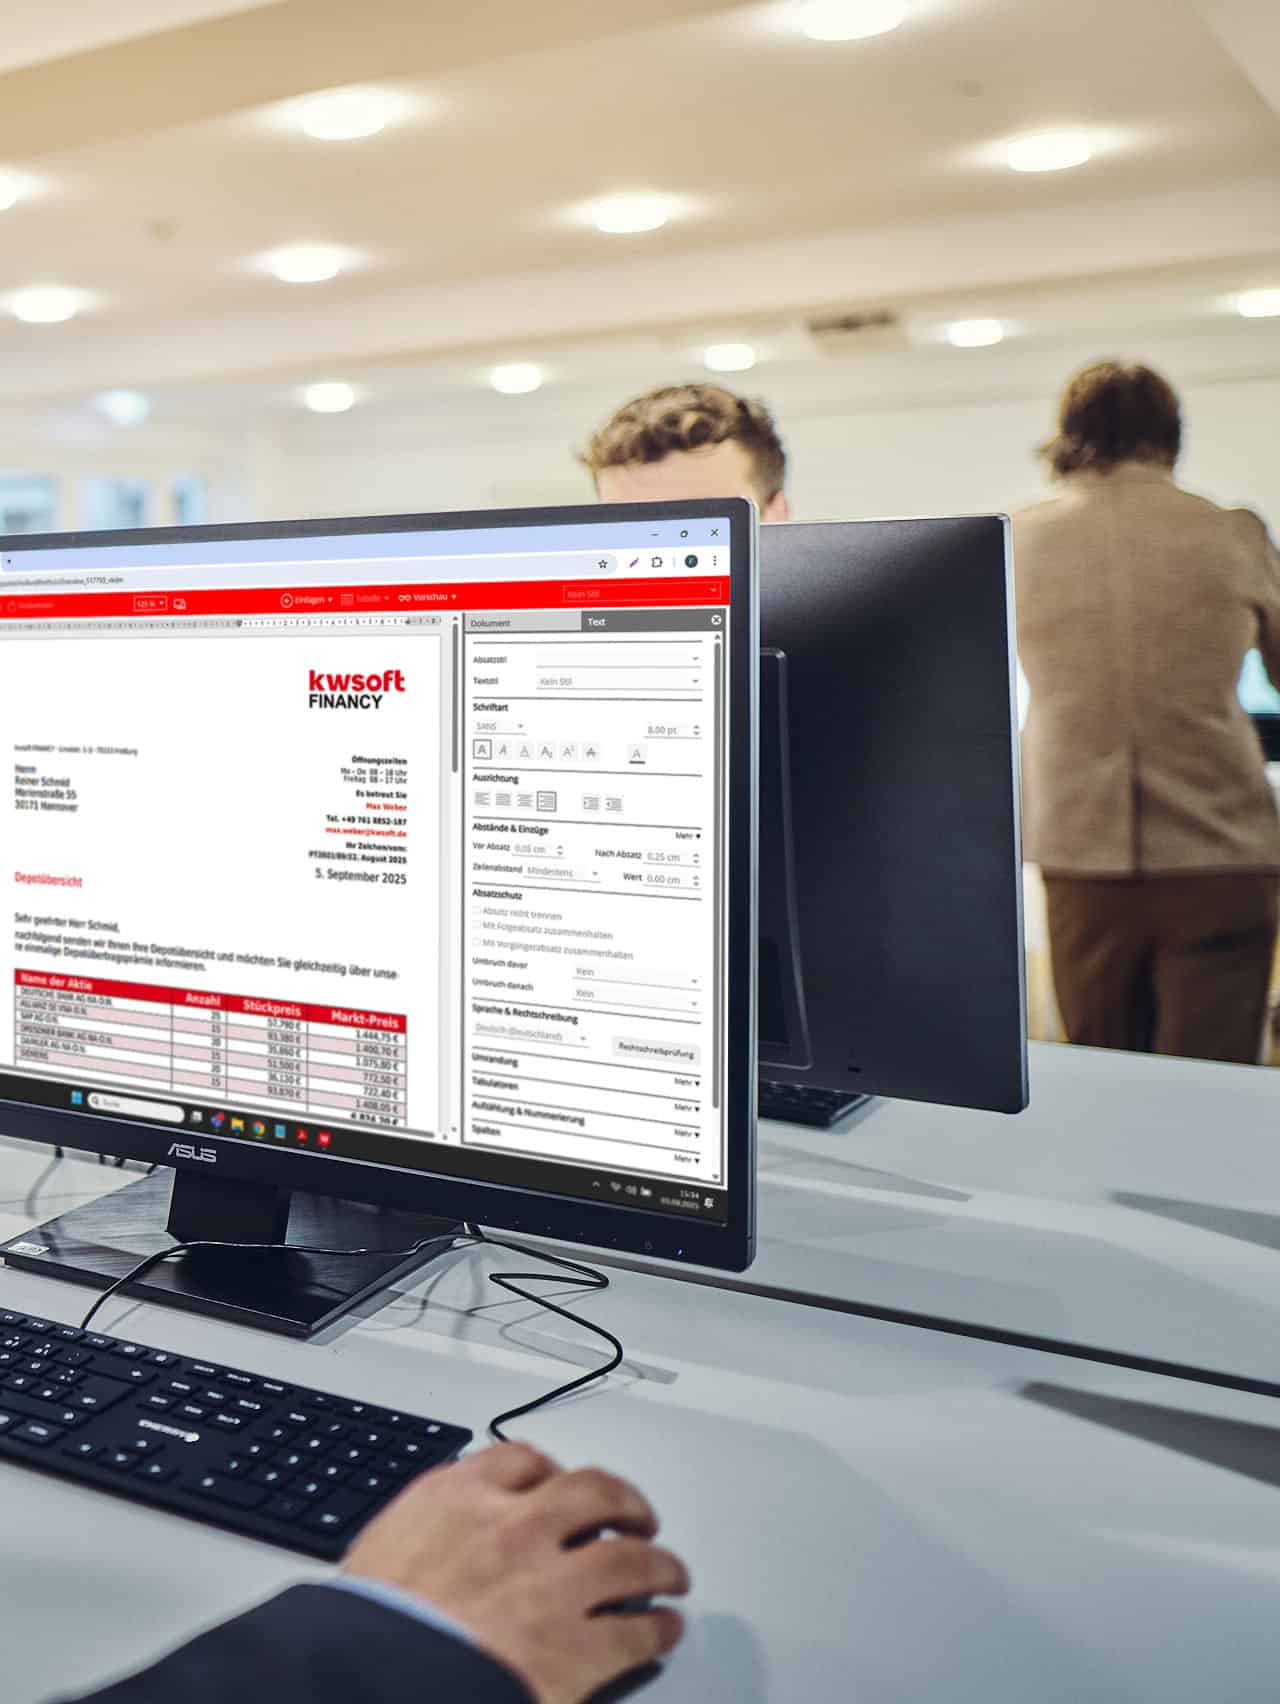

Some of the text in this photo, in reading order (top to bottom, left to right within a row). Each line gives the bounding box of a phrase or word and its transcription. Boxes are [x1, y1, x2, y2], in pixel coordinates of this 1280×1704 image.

[414, 593, 448, 601] Vorschau
[470, 619, 510, 627] Dokument
[588, 618, 605, 626] Text
[473, 655, 507, 664] Absatzstil
[309, 669, 405, 692] kwsoft
[309, 694, 383, 709] FINANCY
[473, 703, 509, 712] Schriftart
[668, 727, 677, 735] pt
[352, 755, 407, 766] Öffnungszeiten
[15, 776, 70, 787] Reiner Schmid
[473, 774, 518, 784] Ausrichtung
[15, 788, 64, 799] Marienstraße
[366, 790, 393, 798] betreut
[41, 801, 78, 812] Hannover
[366, 802, 407, 811] Max Weber
[473, 823, 548, 836] Abstände & Einzüge
[676, 832, 693, 840] Mehr
[473, 843, 510, 851] Vor Absatz
[361, 854, 387, 863] August
[595, 849, 642, 859] Nach Absatz
[473, 863, 523, 873] Zeilenabstand
[15, 872, 83, 888] Depotübersicht
[316, 868, 407, 884] 5. September 2025
[623, 873, 642, 881] Wert
[668, 876, 680, 884] cm
[472, 889, 522, 900] Absatzschutz
[483, 907, 508, 915] Absatz
[531, 911, 562, 921] trennen
[15, 912, 120, 933] Sehr geehrter Herr Schmid,
[483, 921, 613, 940] Mit Folgeabsatz zusammenhalten
[15, 931, 61, 944] nachfolgend
[63, 936, 91, 946] senden
[94, 939, 105, 947] wir
[108, 939, 130, 951] Ihnen
[133, 942, 148, 952] Ihre
[151, 943, 215, 961] Depotübersicht
[218, 952, 233, 962] und
[236, 953, 275, 967] möchten
[277, 957, 291, 969] Sie
[294, 958, 346, 976] gleichzeitig
[349, 965, 371, 977] über
[483, 939, 634, 960] Mit zusammenhalten
[15, 943, 23, 951] re
[25, 945, 61, 957] einmalige
[156, 958, 206, 972] informieren.
[472, 957, 528, 969] Umbruch davor
[576, 967, 594, 976] Kein
[472, 977, 534, 992] Umbruch danach
[576, 989, 594, 998] Kein
[21, 973, 399, 1028] Name der Aktie Anzahl Stückpreis Markt-Preis
[472, 1004, 578, 1024] Sprache & Rechtschreibung
[618, 1042, 694, 1060] Rechtschreibprüfung
[472, 1052, 518, 1068] Umrandung
[472, 1076, 519, 1091] Tabulatoren
[674, 1078, 692, 1086] Mehr
[674, 1103, 692, 1112] Mehr
[472, 1101, 585, 1126] Aufzählung & Nummerierung
[472, 1124, 501, 1136] Spalten
[674, 1129, 692, 1137] Mehr
[168, 1143, 216, 1162] ASUS
[674, 1154, 692, 1163] Mehr
